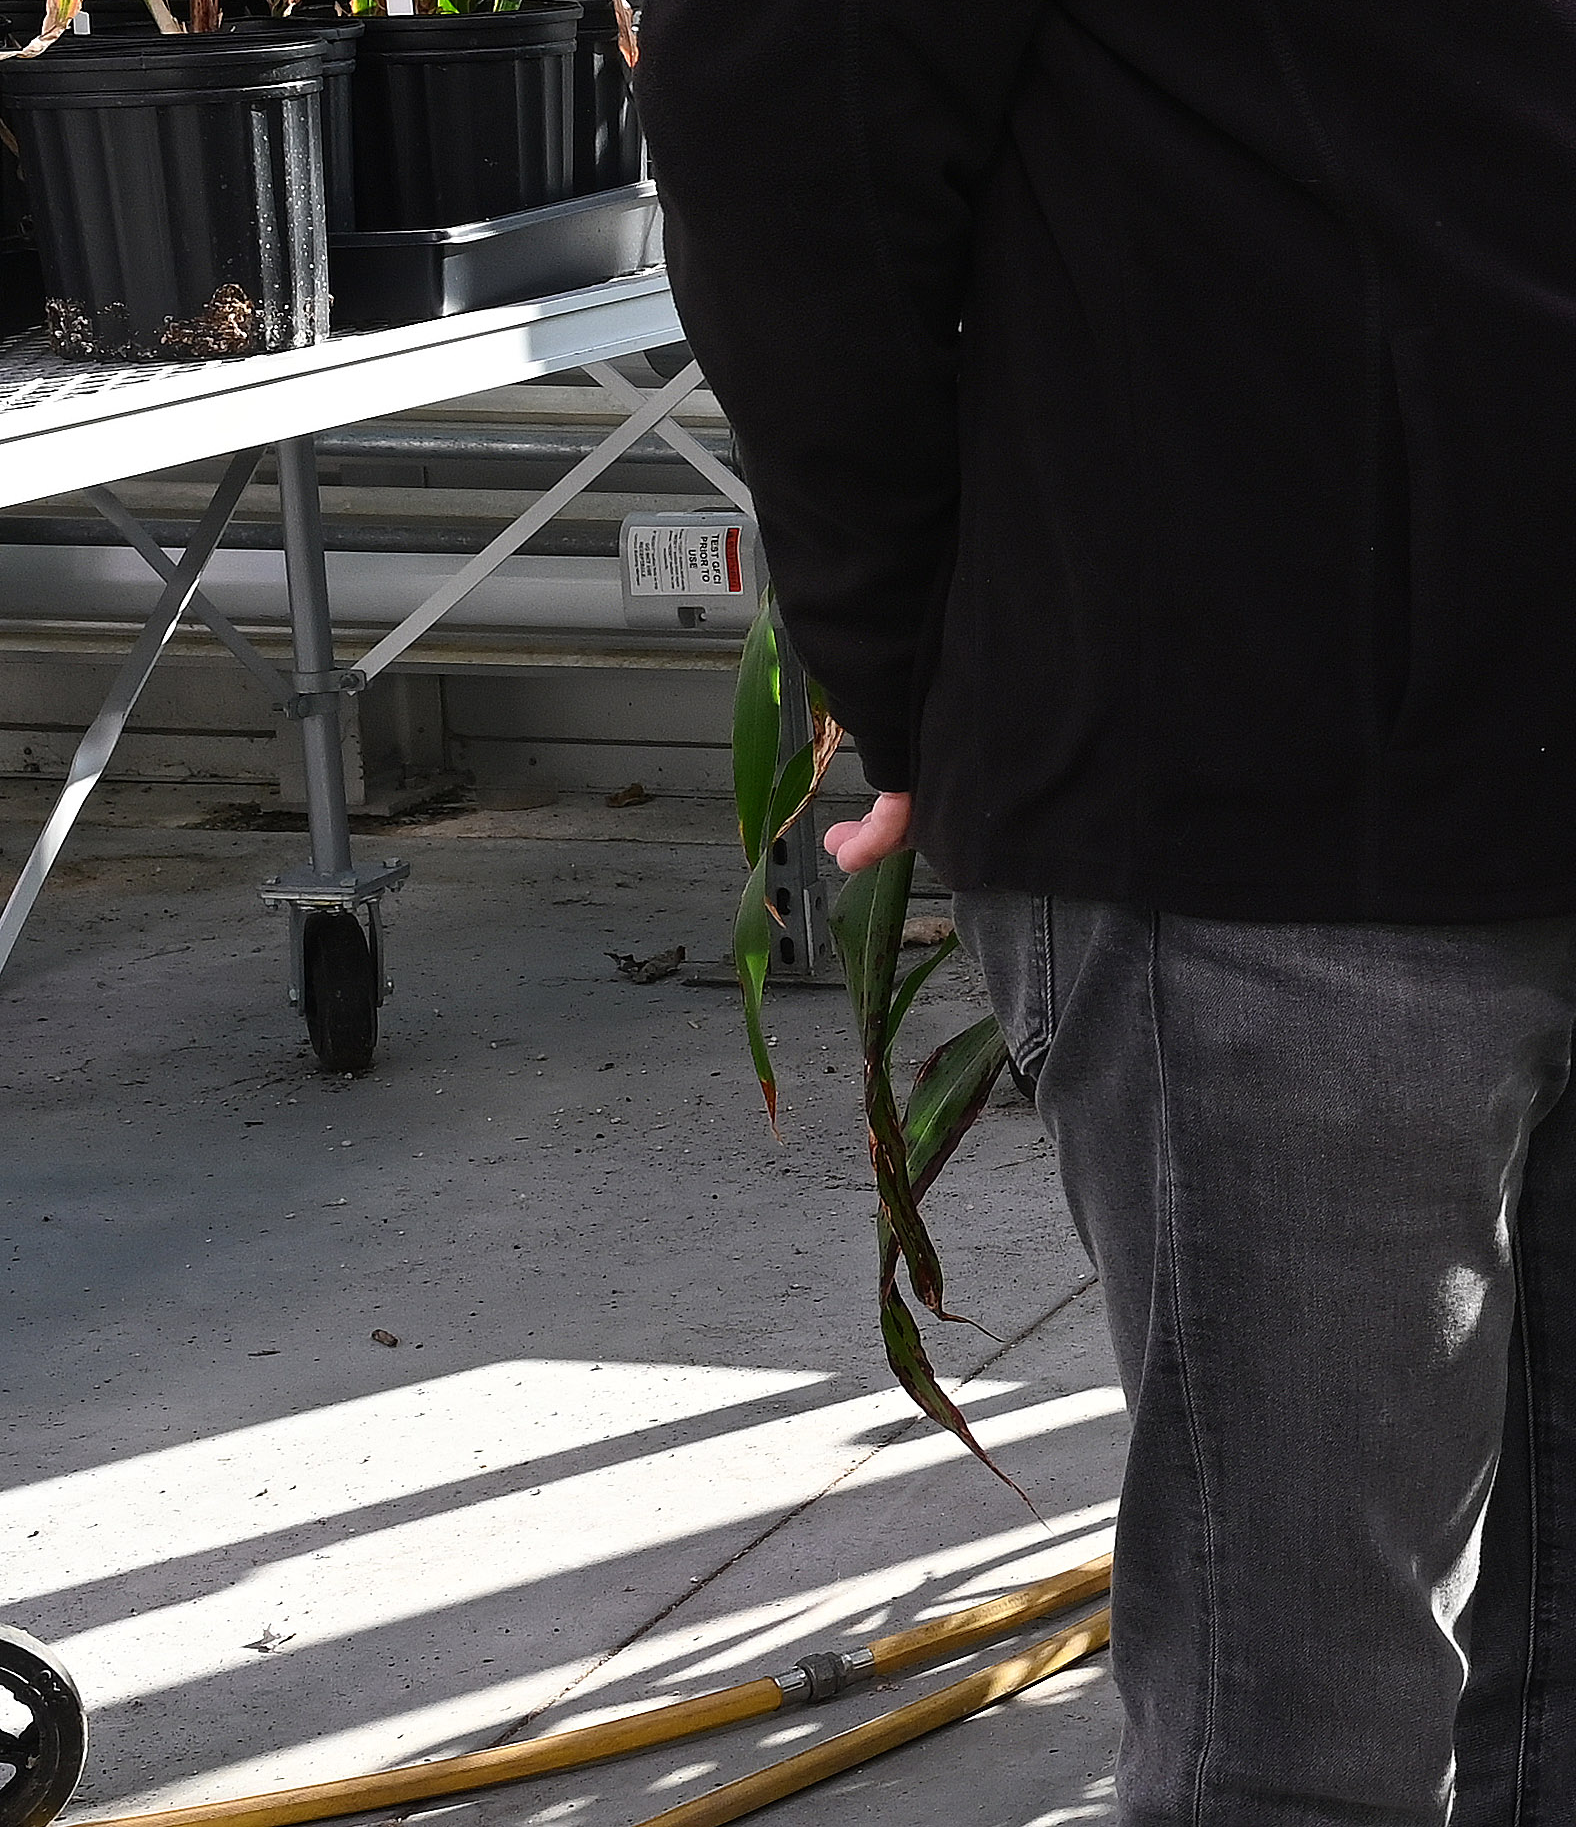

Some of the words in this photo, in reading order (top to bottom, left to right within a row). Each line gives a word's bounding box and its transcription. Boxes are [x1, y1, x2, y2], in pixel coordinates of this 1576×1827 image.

[699, 536, 708, 567] PRIOR
[711, 534, 720, 559] TEST
[688, 549, 698, 569] USE
[701, 569, 710, 583] TO
[712, 561, 721, 585] GFCI
